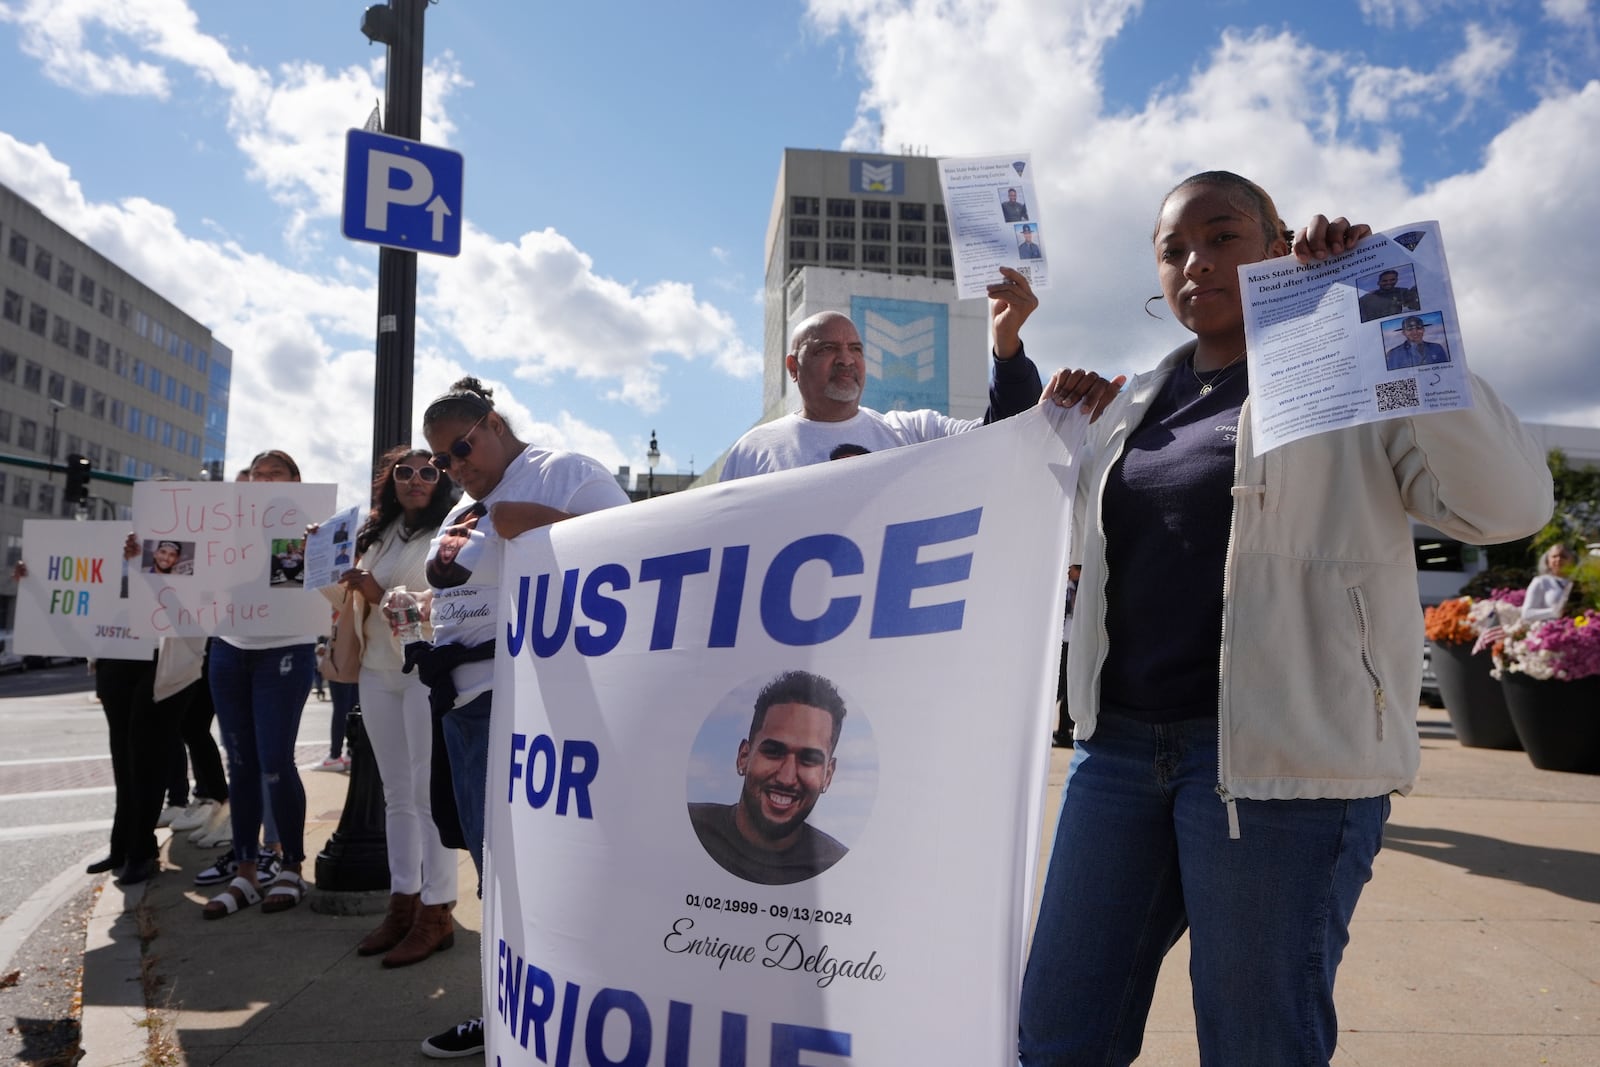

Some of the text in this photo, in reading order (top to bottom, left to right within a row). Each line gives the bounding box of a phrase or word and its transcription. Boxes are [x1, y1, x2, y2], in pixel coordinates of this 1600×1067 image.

[365, 149, 434, 231] P
[1248, 240, 1388, 283] Mass State Police Trainee Recruit
[1259, 254, 1377, 293] Dead after Training Exercise
[1251, 299, 1267, 307] What
[1268, 292, 1299, 304] happened
[1271, 351, 1341, 377] Why does this matter?
[1278, 396, 1295, 406] What
[1309, 389, 1322, 397] you
[1323, 384, 1335, 393] do?
[151, 488, 297, 534] Justice
[48, 555, 104, 584] HONK
[207, 541, 254, 566] For
[507, 506, 983, 658] JUSTICE
[50, 589, 90, 616] FOR
[151, 586, 269, 631] Enrique
[95, 625, 139, 640] JUSTIC
[508, 733, 599, 820] FOR
[686, 894, 758, 914] 01/02/1999
[769, 904, 853, 926] 09/13/2024
[663, 917, 886, 988] Enrique Delgado
